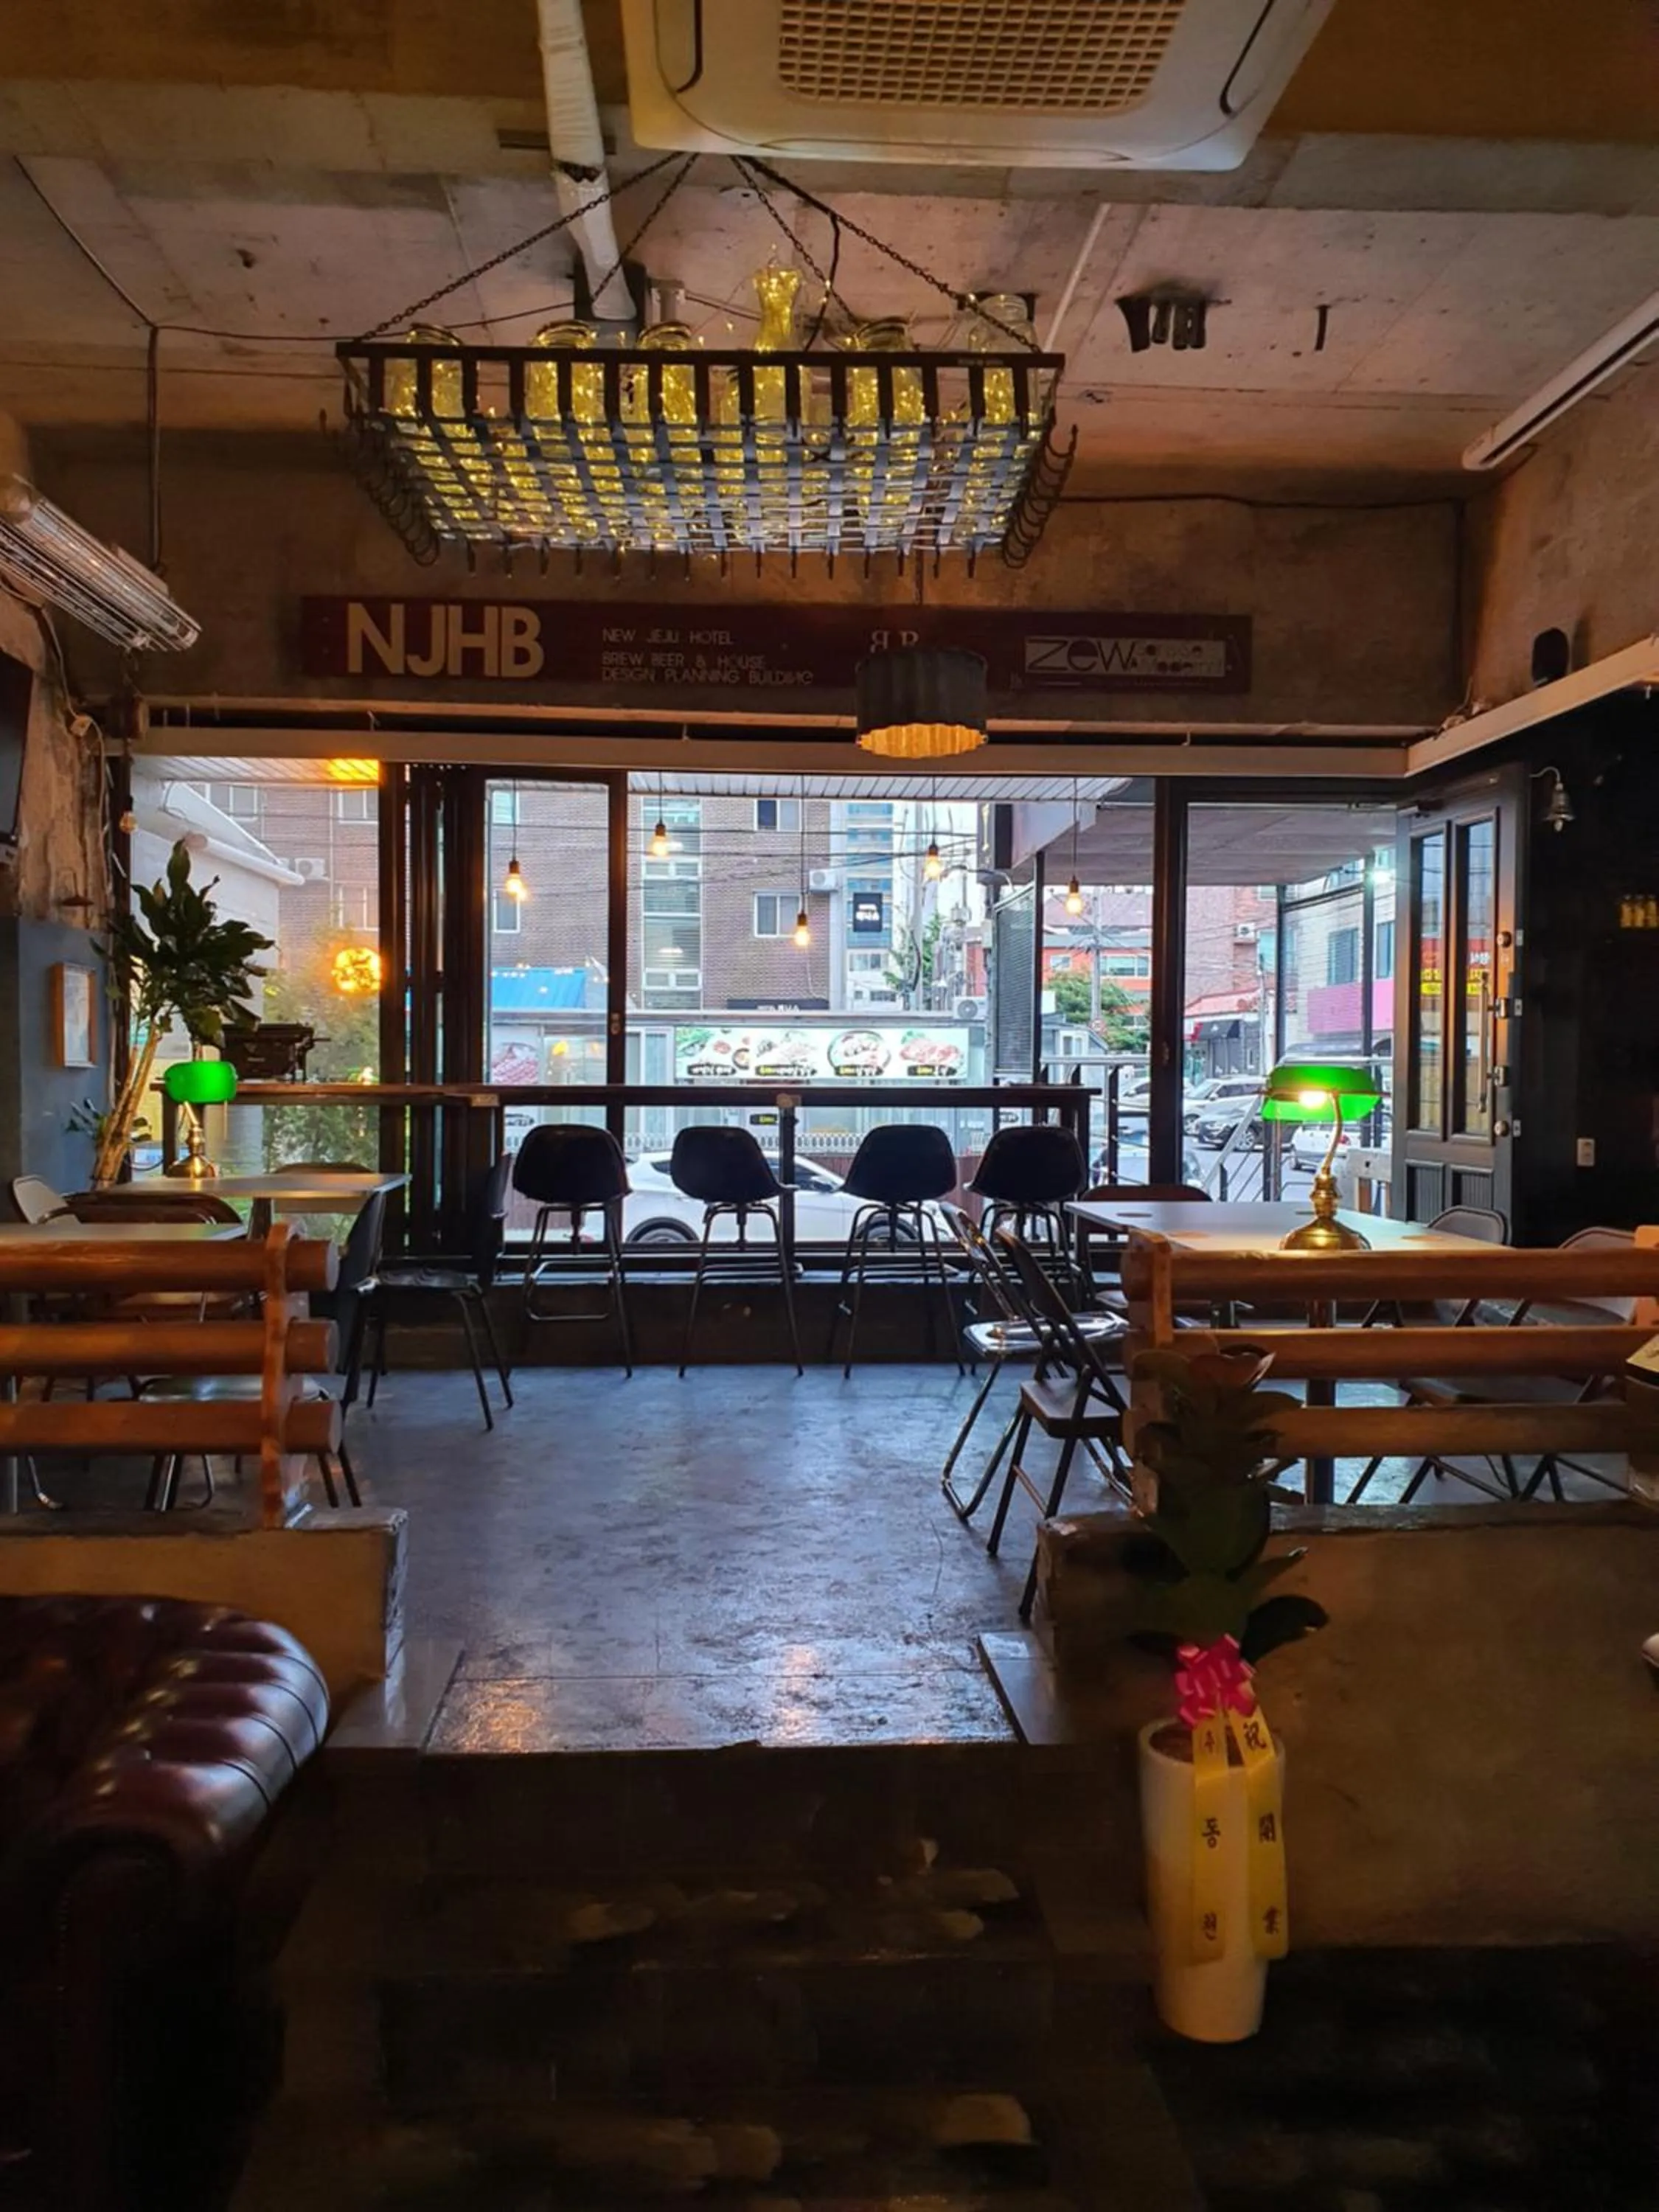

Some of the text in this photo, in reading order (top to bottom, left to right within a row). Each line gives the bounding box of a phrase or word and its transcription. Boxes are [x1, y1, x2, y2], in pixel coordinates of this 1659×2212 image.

[347, 602, 545, 678] NJHB
[602, 628, 734, 646] NEW JEJU HOTEL
[602, 652, 644, 667] BREW
[650, 652, 685, 667] BEER
[717, 654, 766, 670] HOUSE
[601, 667, 814, 686] DESIGN PLANNING BUILDING
